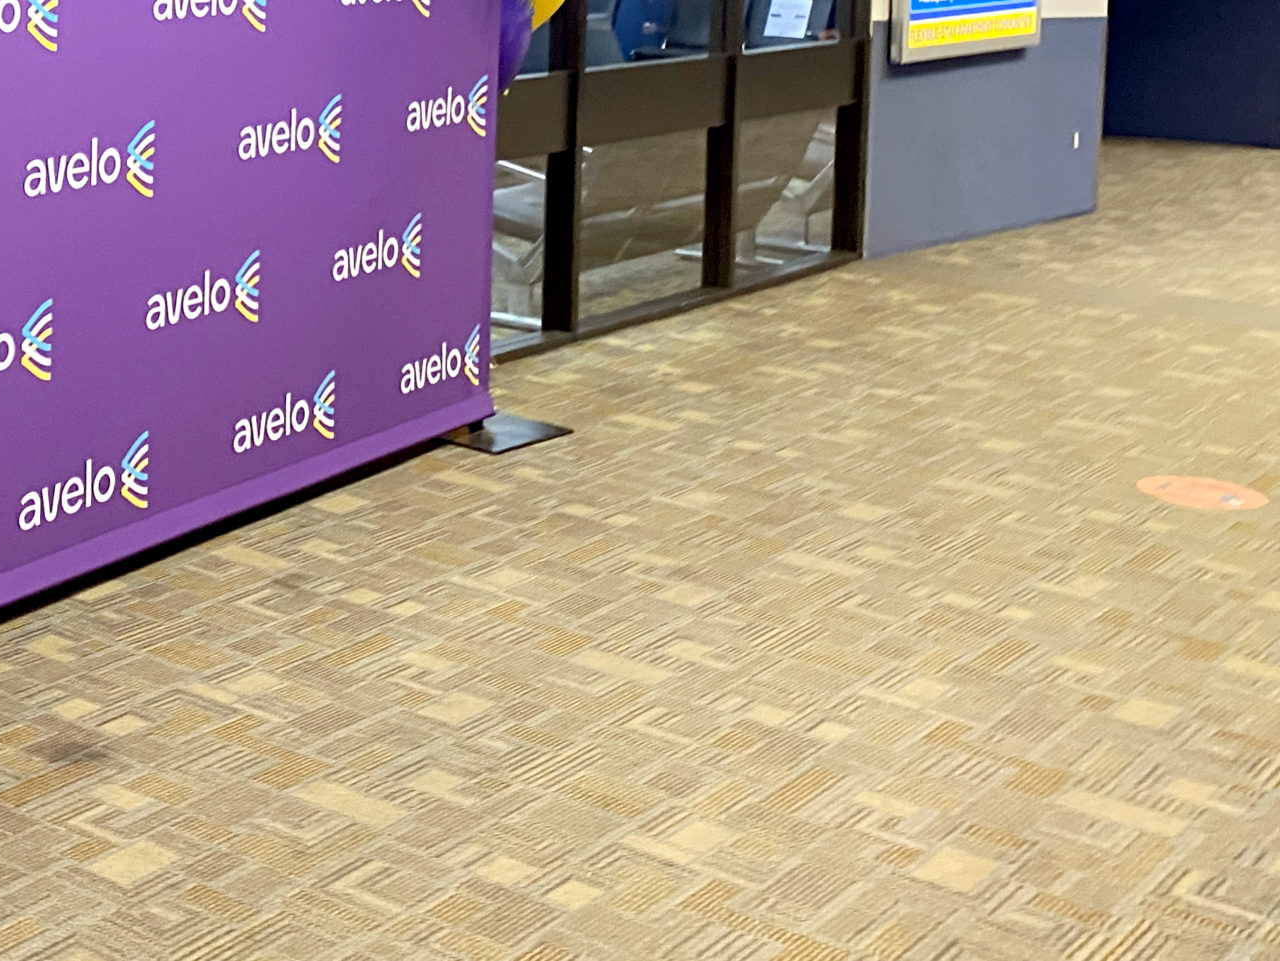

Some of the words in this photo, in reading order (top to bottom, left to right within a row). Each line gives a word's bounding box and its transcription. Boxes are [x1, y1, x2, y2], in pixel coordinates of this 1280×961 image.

[238, 107, 315, 160] avelo
[406, 86, 465, 132] avelo
[24, 137, 121, 197] avelo
[332, 228, 399, 282] avelo
[145, 269, 231, 331] avelo
[400, 341, 462, 394] avelo
[233, 392, 310, 453] avelo
[18, 458, 116, 531] avelo
